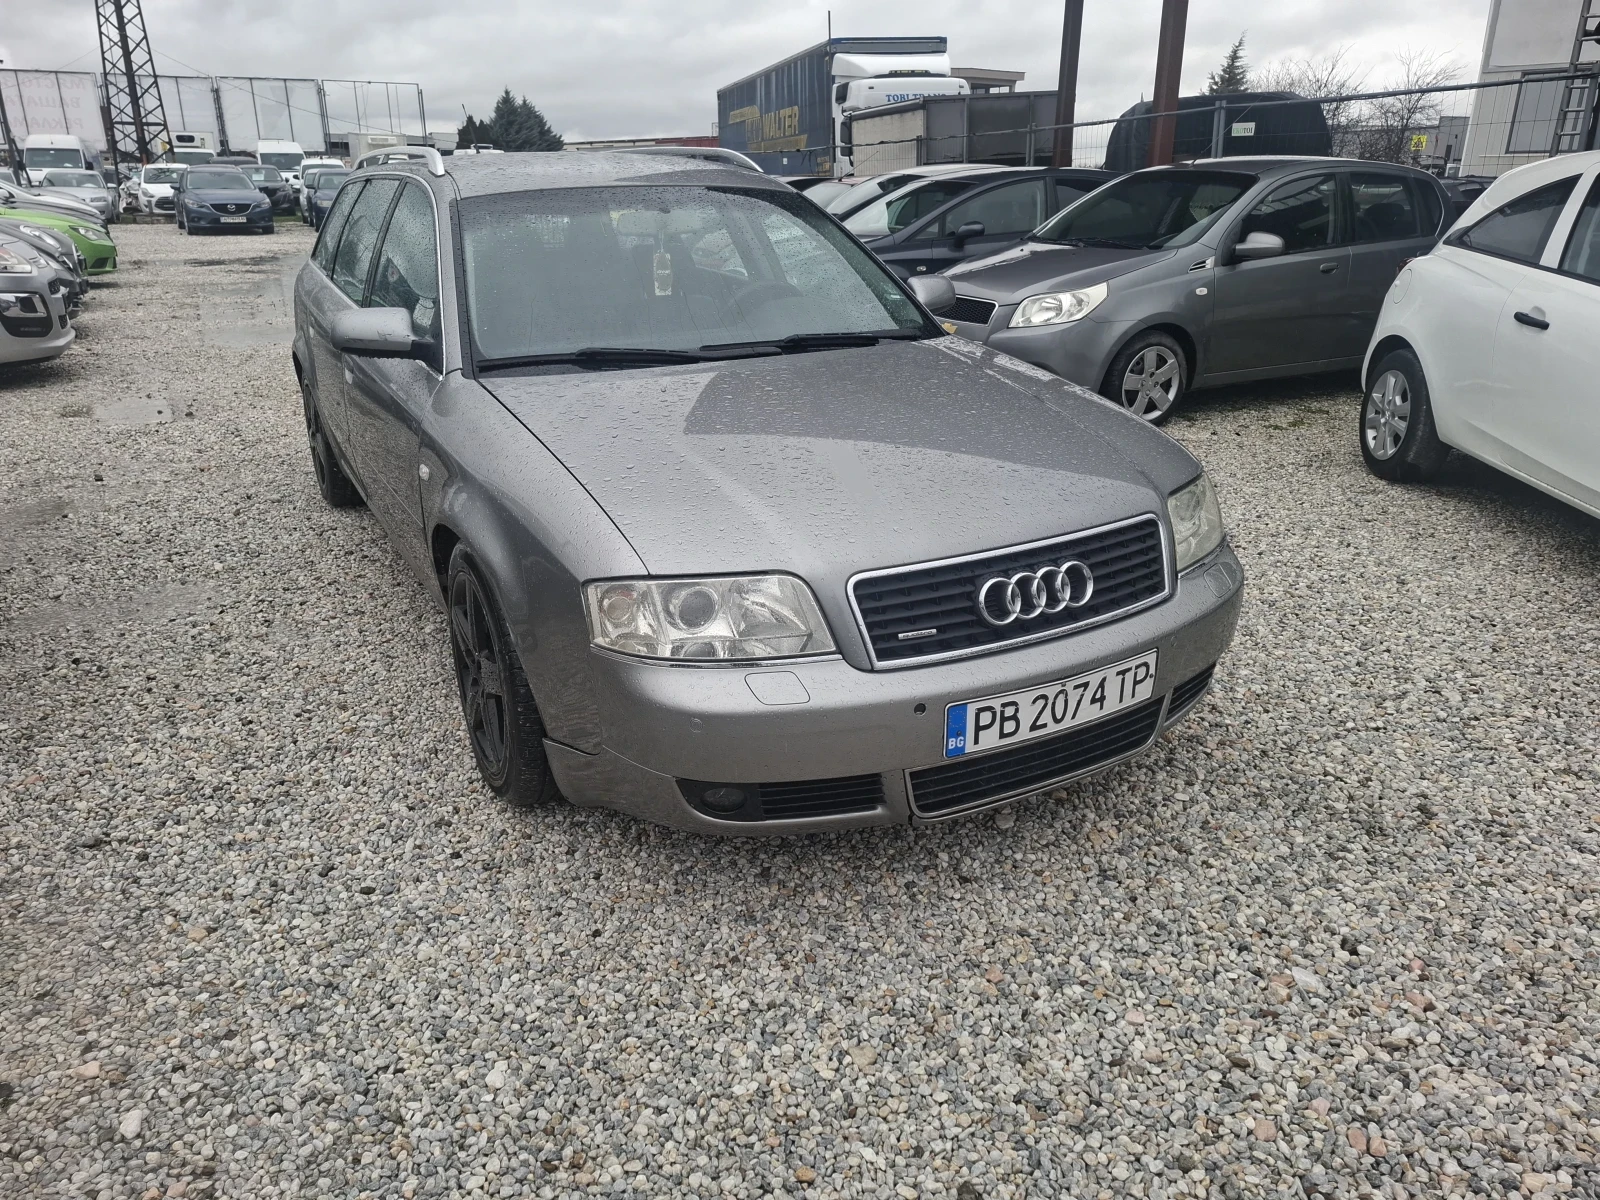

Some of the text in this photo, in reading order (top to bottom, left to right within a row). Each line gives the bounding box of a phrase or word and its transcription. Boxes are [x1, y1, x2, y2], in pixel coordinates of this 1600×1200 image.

[763, 105, 799, 140] WALTER
[973, 660, 1150, 746] PB 2074 TP
[948, 736, 965, 750] BG
